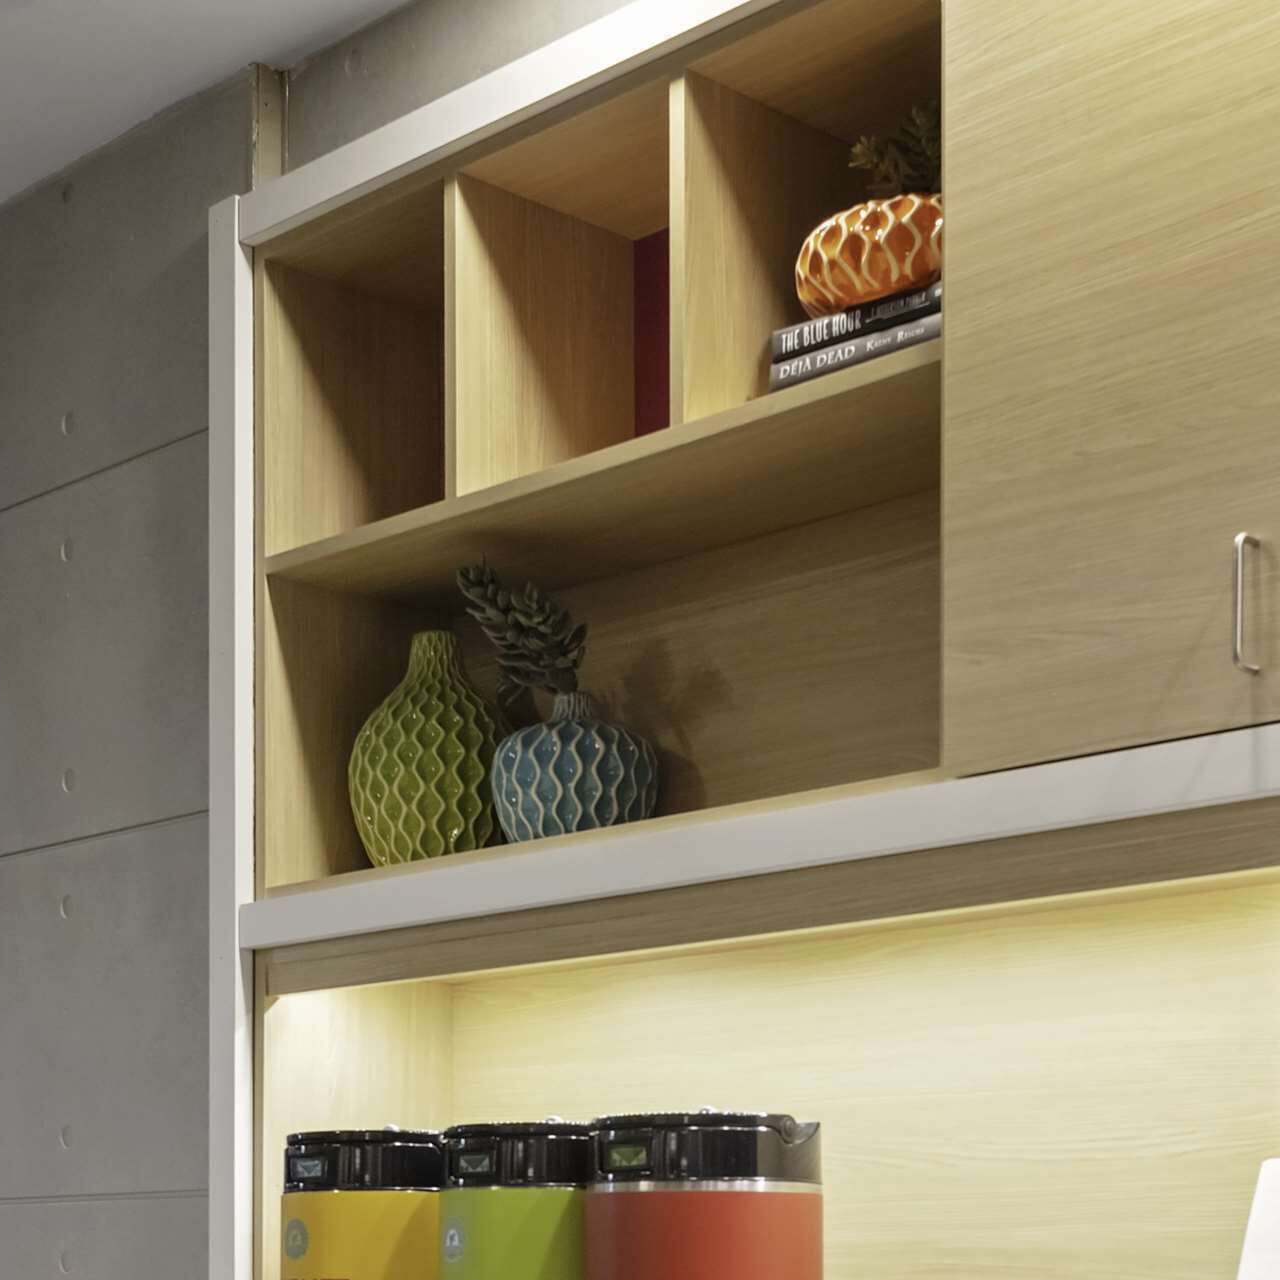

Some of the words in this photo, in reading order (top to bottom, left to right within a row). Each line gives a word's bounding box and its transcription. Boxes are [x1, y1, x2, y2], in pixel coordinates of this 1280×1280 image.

[781, 328, 800, 354] THE
[803, 319, 828, 347] BLUE
[832, 309, 862, 336] HOUR
[816, 345, 855, 368] DEAD
